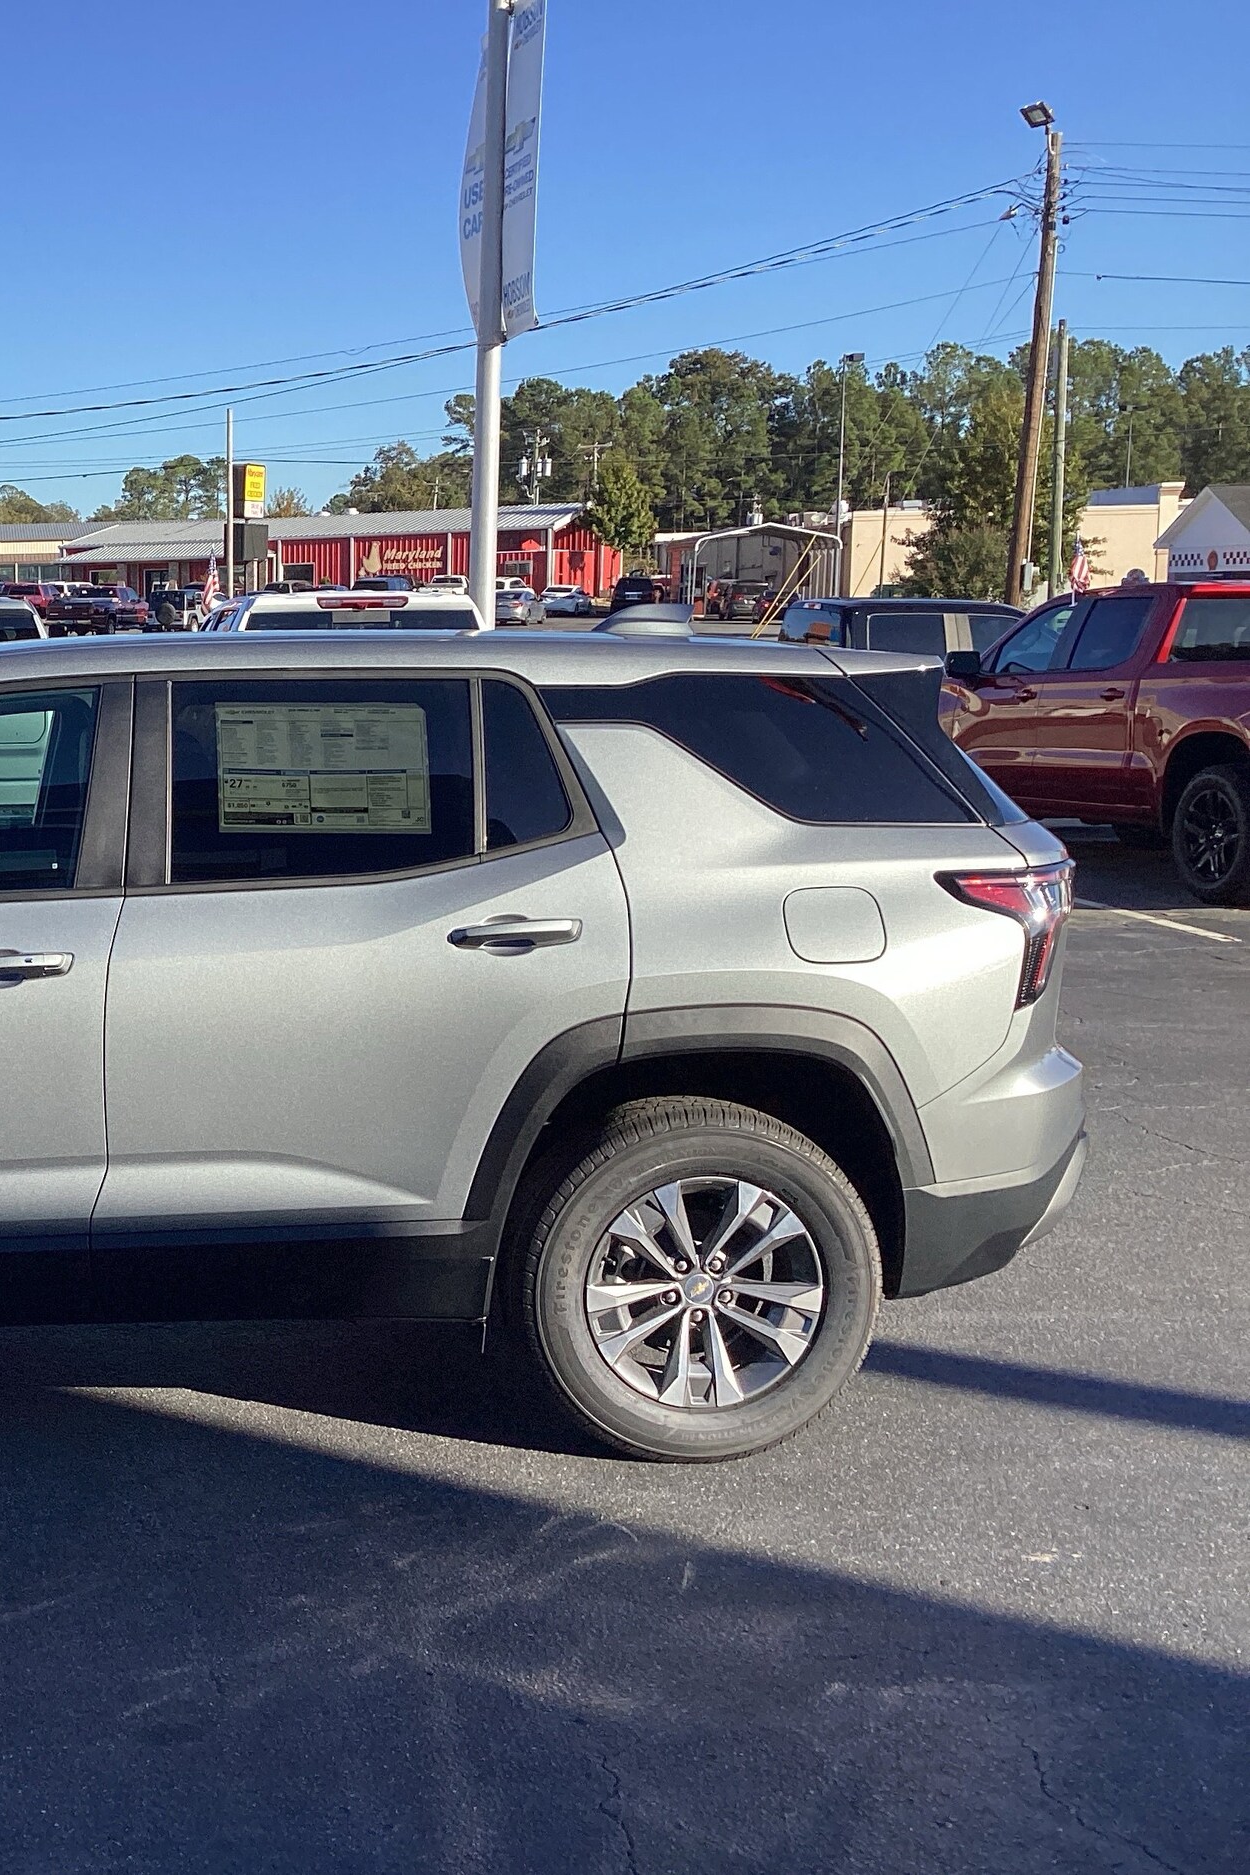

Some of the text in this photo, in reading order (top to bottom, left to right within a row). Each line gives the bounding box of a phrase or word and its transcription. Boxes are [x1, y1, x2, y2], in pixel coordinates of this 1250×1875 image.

[384, 545, 444, 562] Maryland
[383, 560, 443, 570] FRIED CHICKEN
[229, 778, 243, 789] 27
[553, 1201, 600, 1316] Firestone
